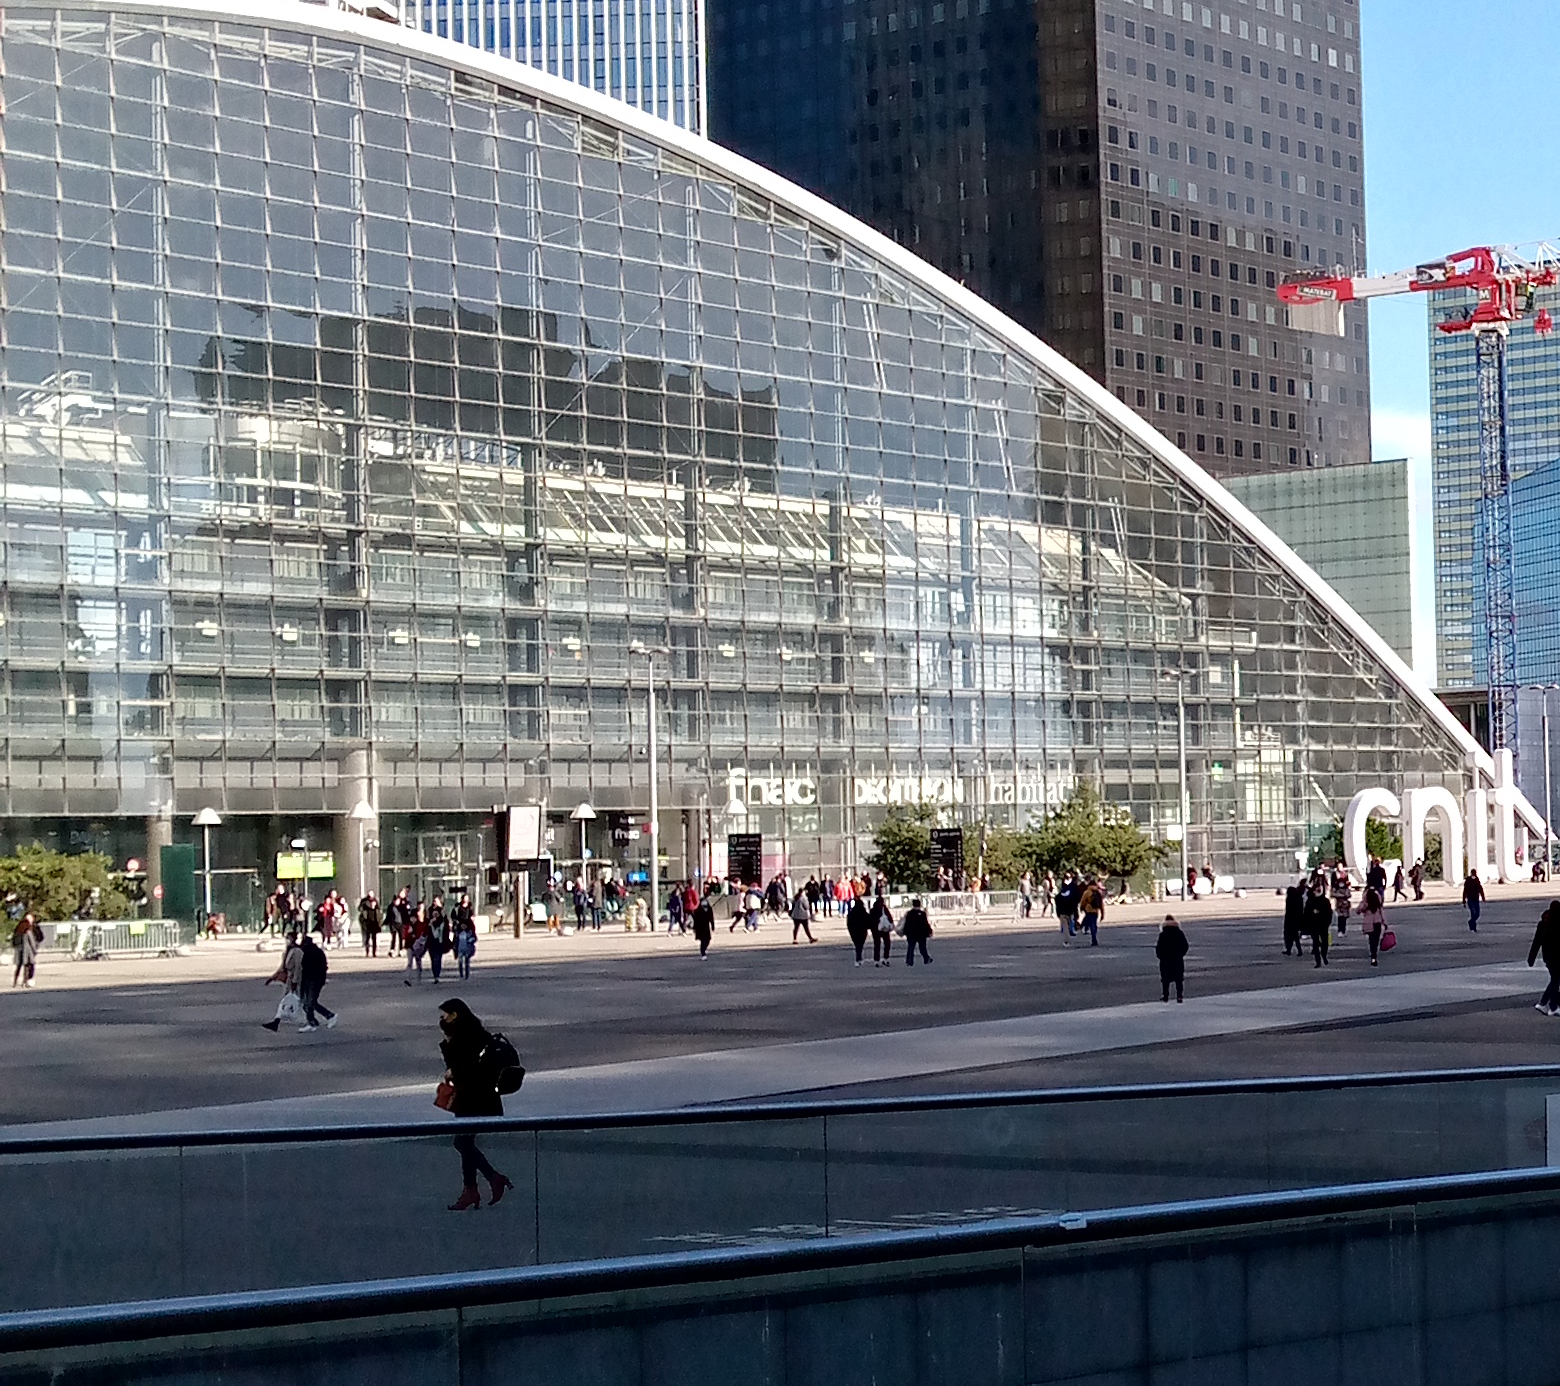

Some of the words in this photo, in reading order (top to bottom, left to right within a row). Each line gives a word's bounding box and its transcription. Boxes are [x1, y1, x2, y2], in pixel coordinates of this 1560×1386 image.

[727, 767, 816, 805] fnac
[988, 772, 1067, 804] habitat
[1344, 748, 1536, 888] cnit
